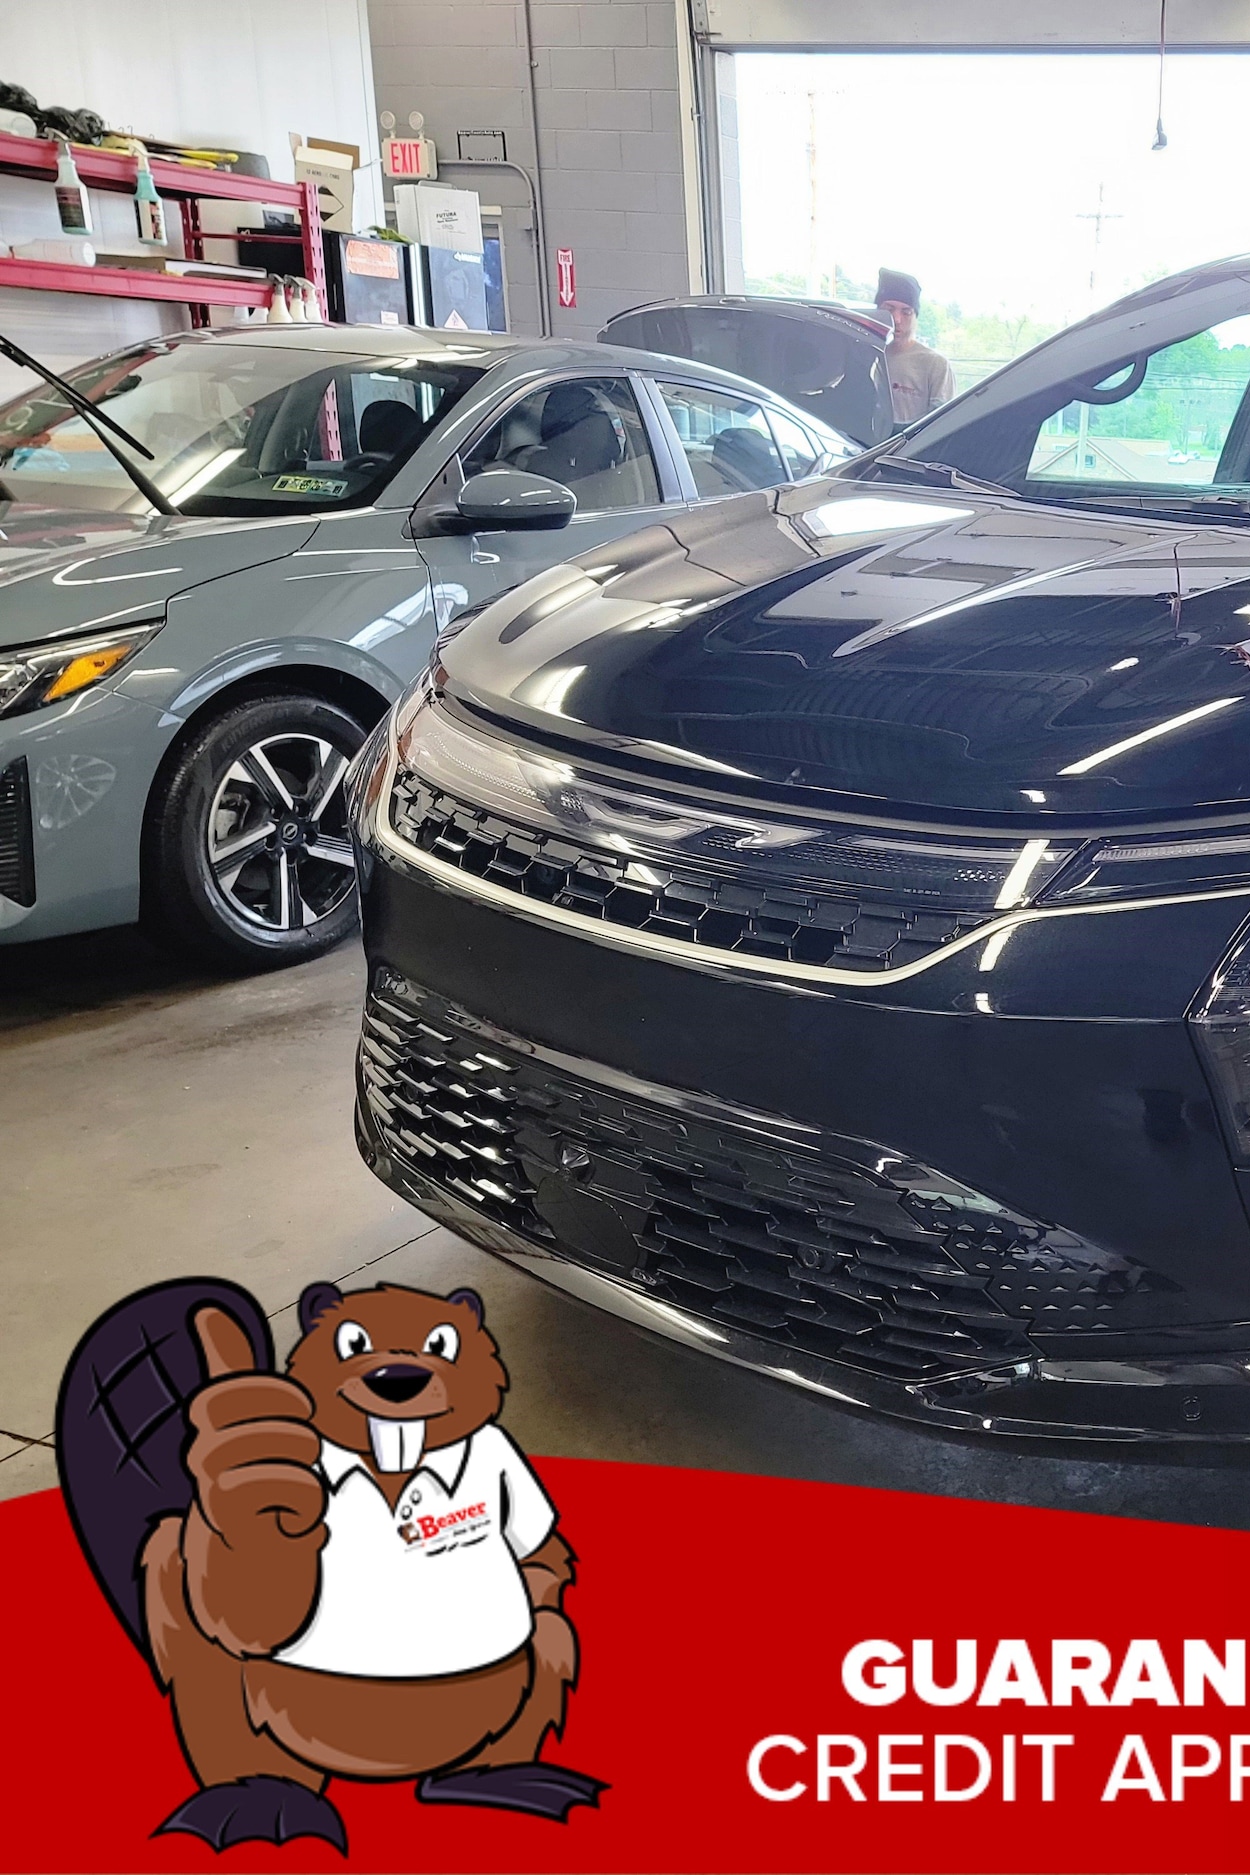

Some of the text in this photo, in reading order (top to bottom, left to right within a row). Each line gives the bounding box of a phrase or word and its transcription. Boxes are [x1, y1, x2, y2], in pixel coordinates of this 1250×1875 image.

[390, 143, 420, 174] EXIT
[436, 211, 457, 219] FUTURA
[560, 254, 571, 262] FIRE
